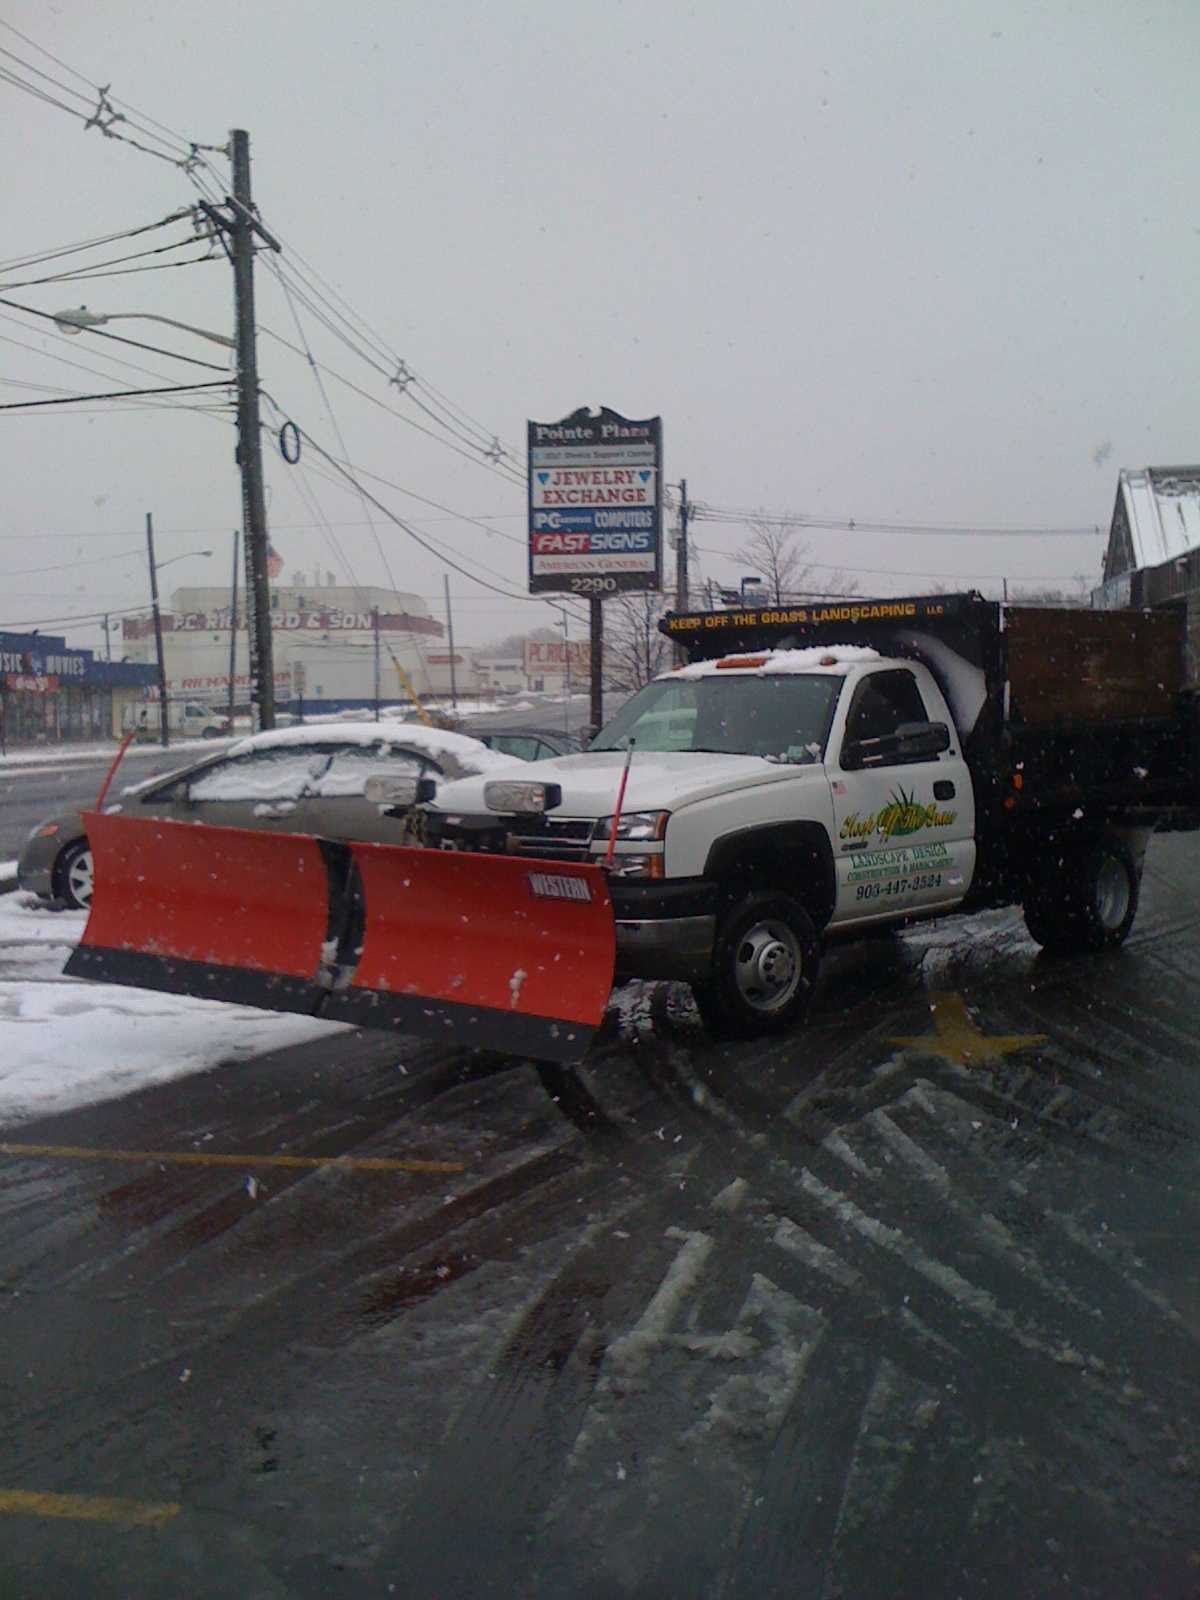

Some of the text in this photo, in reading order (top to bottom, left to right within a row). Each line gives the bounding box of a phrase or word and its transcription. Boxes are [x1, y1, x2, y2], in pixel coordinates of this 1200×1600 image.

[536, 424, 650, 440] Pointe Plaza
[552, 471, 636, 486] JEWELRY
[543, 488, 647, 504] EXCHANGE
[594, 510, 653, 528] COMPUTERS
[571, 578, 617, 592] 2290
[328, 613, 372, 630] SON
[669, 617, 702, 630] KEEP
[705, 616, 729, 628] OFF
[733, 614, 757, 626] THE
[761, 611, 807, 625] GRASS
[812, 603, 917, 621] LANDSCAPING
[849, 841, 949, 869] LANDSCAPE DESIGN
[529, 872, 592, 901] WESTERN
